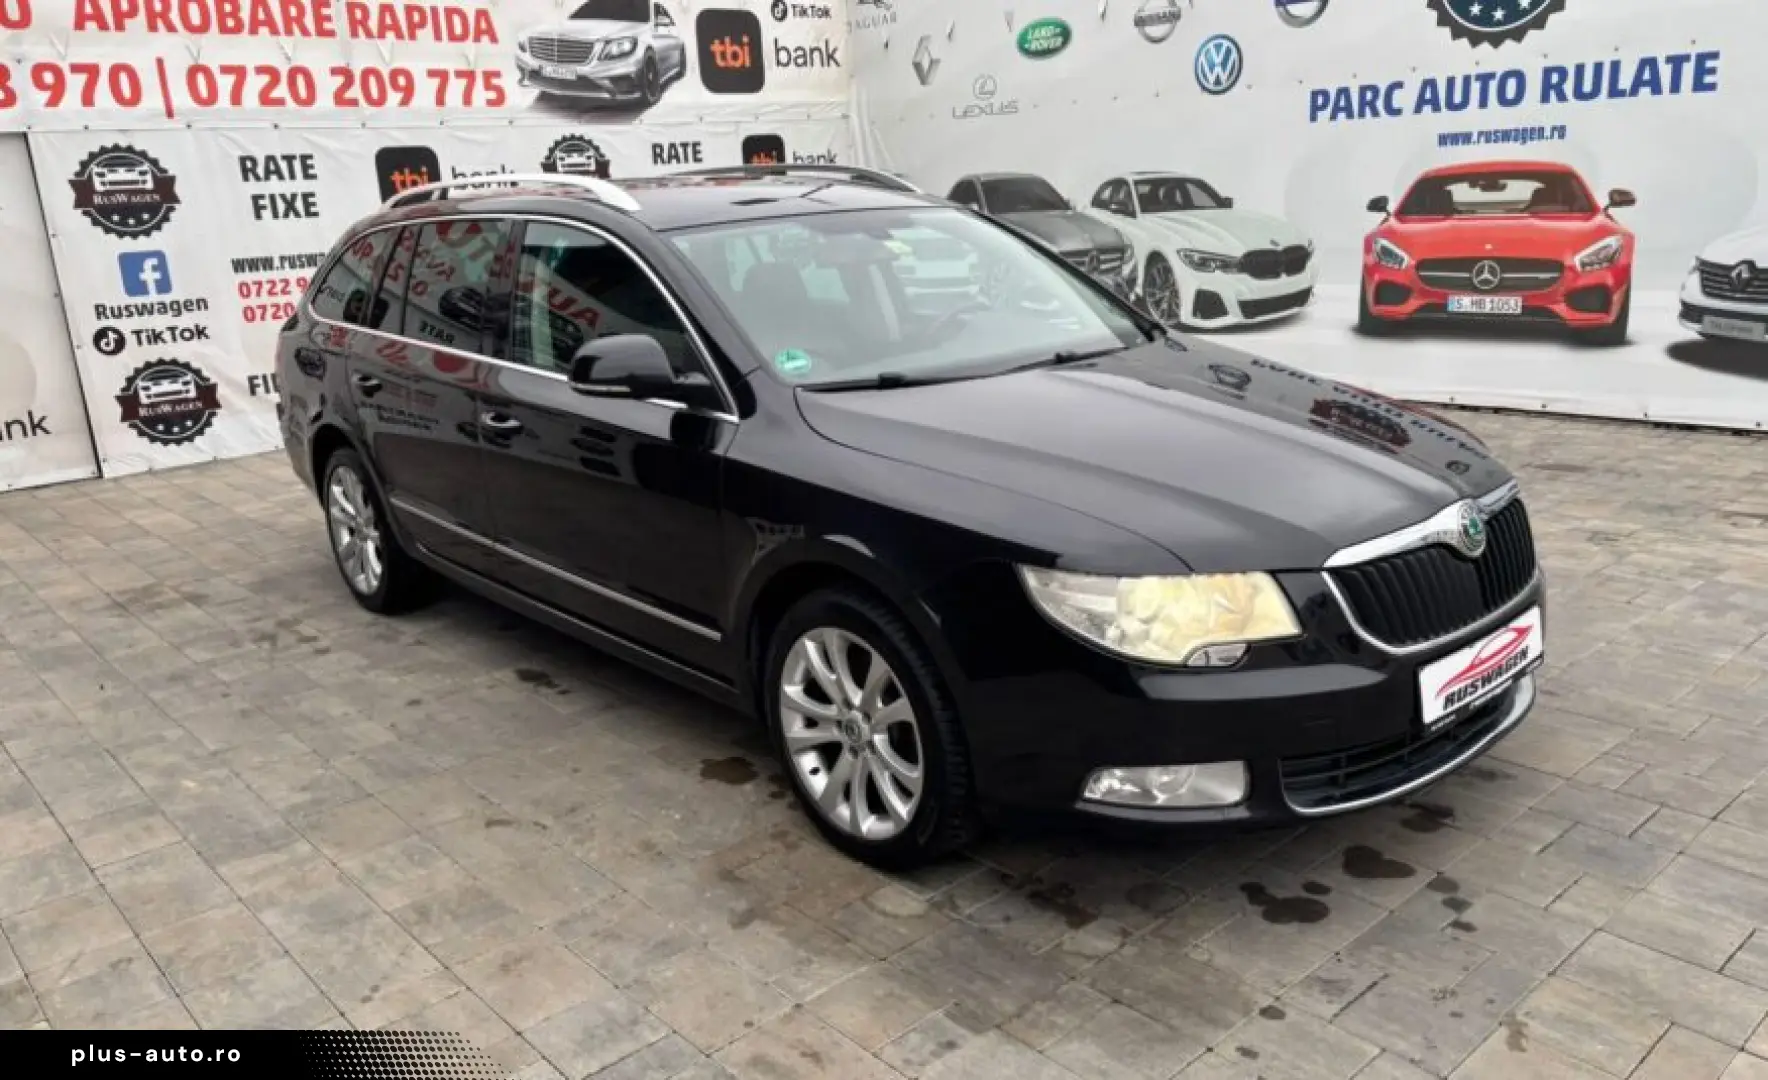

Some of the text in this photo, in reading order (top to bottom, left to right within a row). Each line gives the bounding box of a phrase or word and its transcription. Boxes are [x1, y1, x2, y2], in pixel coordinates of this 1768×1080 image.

[74, 0, 337, 37] APROBARE
[346, 2, 500, 44] RAPIDA
[791, 3, 832, 19] TikTok
[710, 35, 841, 68] tbi bank
[30, 62, 142, 108] 970
[186, 64, 317, 108] 0720
[330, 65, 416, 108] 209
[426, 69, 506, 107] 775
[1309, 51, 1720, 122] PARC AUTO RULATE
[1437, 125, 1567, 148] www.ruswagen.ro
[652, 140, 704, 165] RATE
[239, 153, 318, 183] RATE
[251, 192, 320, 221] FIXE
[237, 277, 292, 299] 0722
[94, 297, 209, 321] Ruswagen
[242, 302, 296, 323] 0720
[131, 324, 210, 347] TikTok
[1442, 645, 1530, 711] RUSWAGEN
